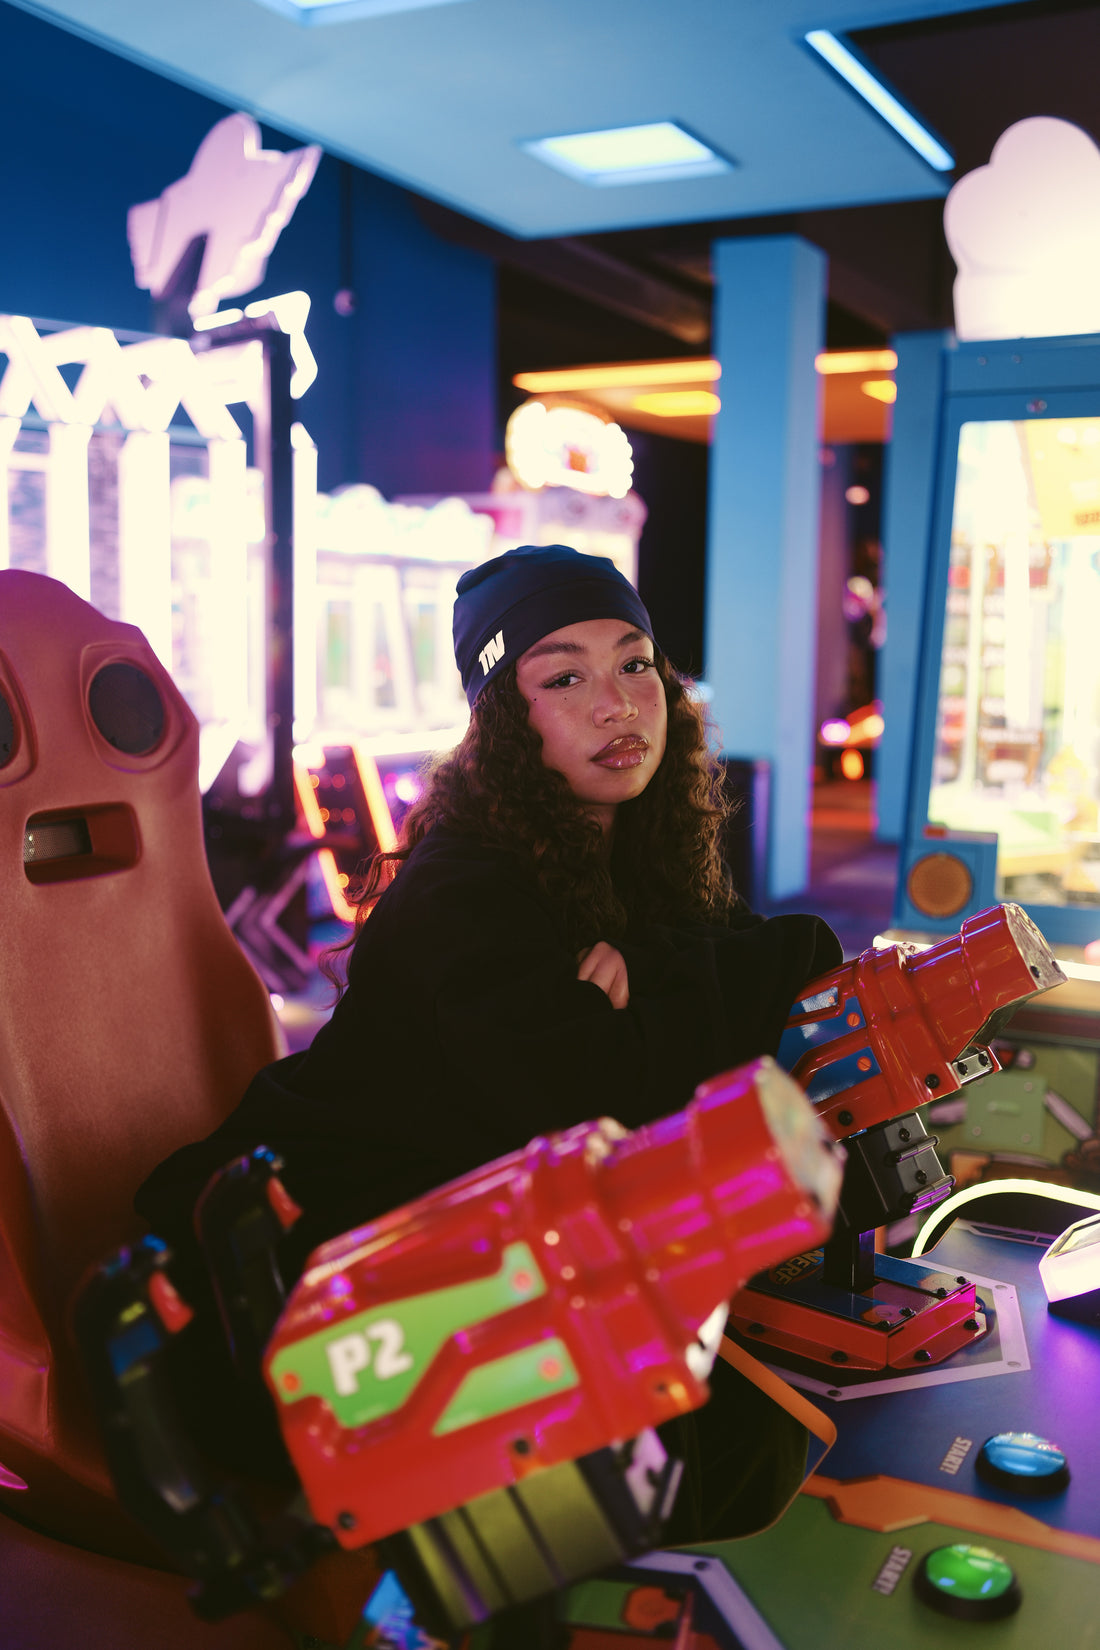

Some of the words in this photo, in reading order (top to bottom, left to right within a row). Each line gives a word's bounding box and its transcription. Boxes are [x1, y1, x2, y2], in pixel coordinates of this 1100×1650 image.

[775, 1249, 825, 1286] NERF
[325, 1318, 415, 1397] P2
[939, 1436, 972, 1475] START!
[871, 1545, 913, 1596] START!
